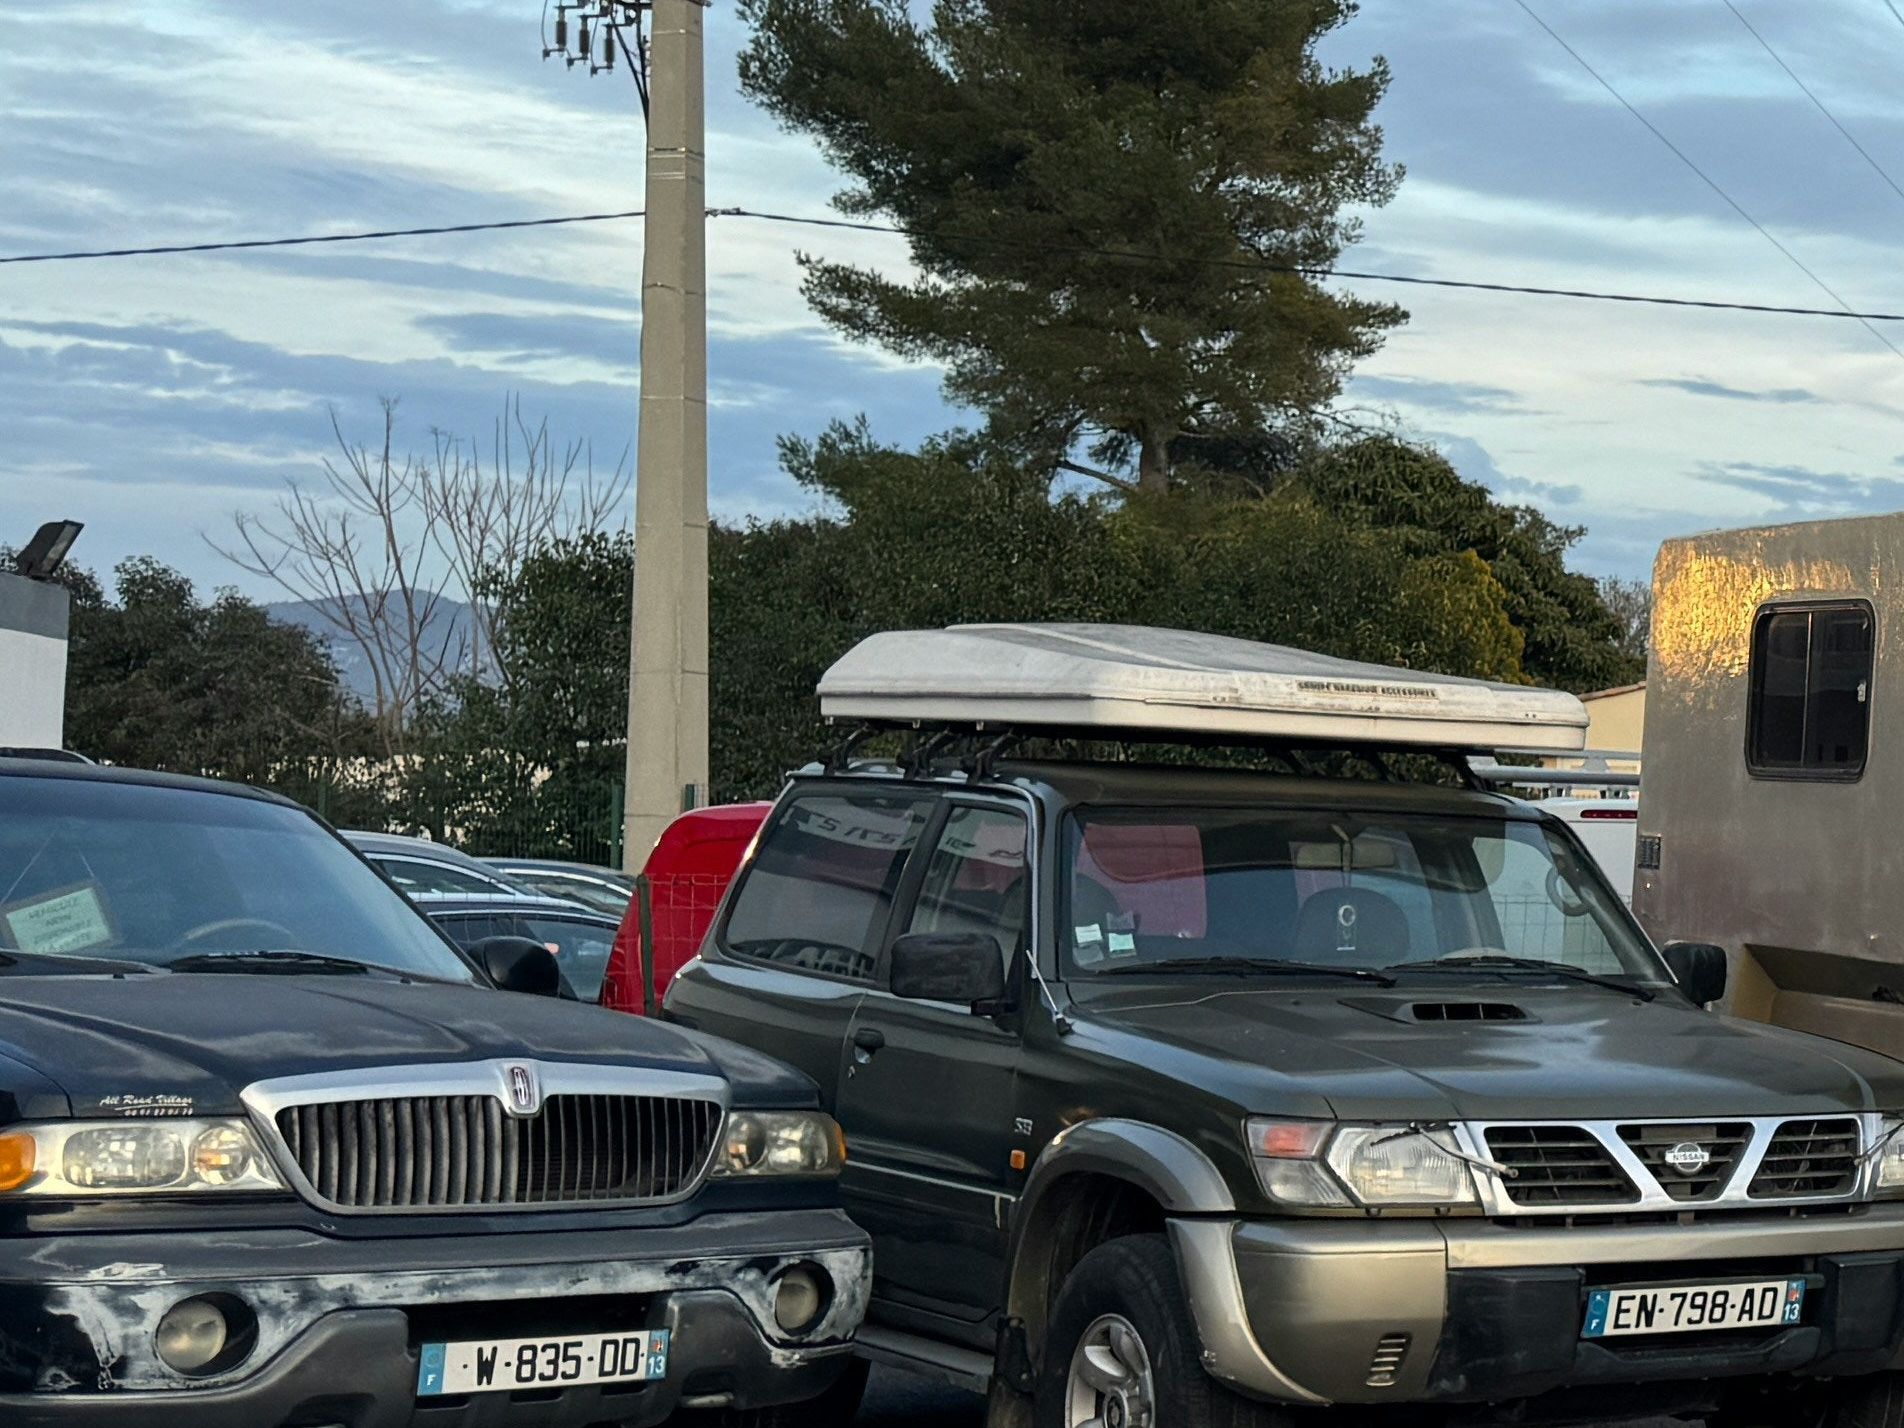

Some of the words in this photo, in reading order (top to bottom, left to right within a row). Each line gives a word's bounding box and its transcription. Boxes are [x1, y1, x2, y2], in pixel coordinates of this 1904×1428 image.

[1783, 1303, 1800, 1321] 13
[1590, 1318, 1600, 1330] F
[648, 1356, 665, 1374] 13
[426, 1374, 436, 1386] F
